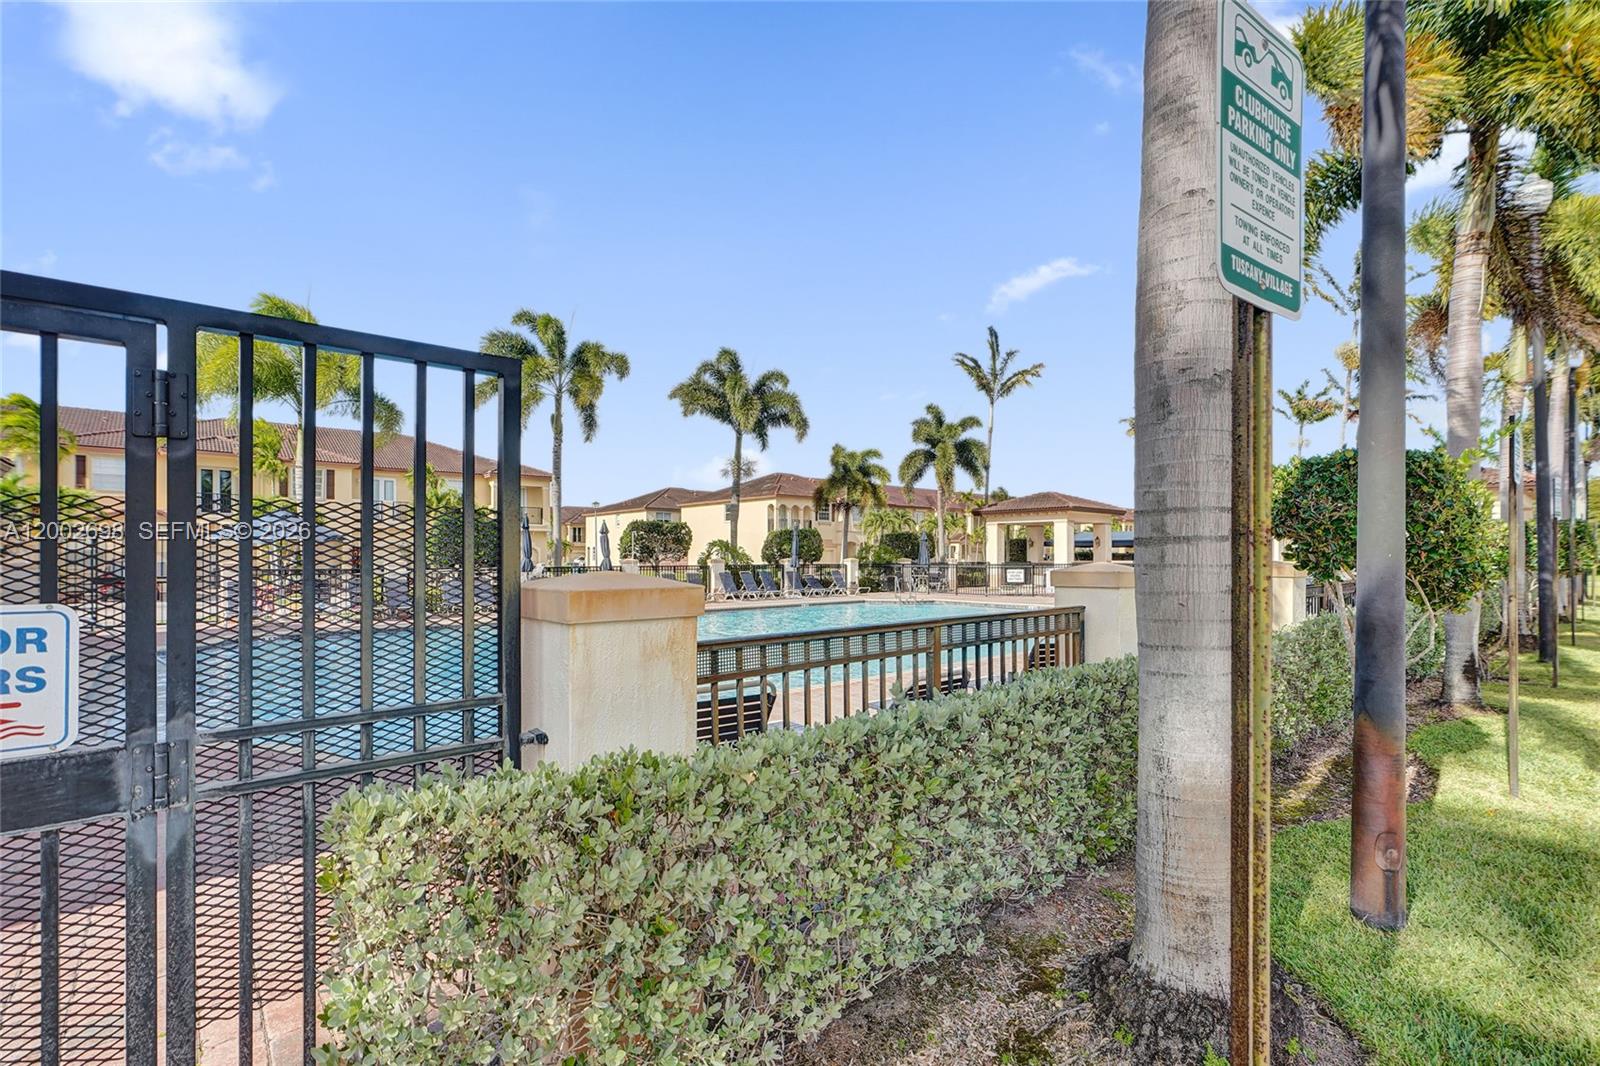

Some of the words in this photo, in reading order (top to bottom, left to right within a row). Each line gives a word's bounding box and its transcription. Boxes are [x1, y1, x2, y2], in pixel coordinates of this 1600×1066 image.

[1235, 84, 1291, 144] CLUBHOUSE
[1228, 104, 1271, 154] PARKING
[1274, 139, 1296, 170] ONLY
[1228, 154, 1241, 172] WILL
[1242, 164, 1250, 178] BE
[1251, 169, 1269, 189] TOWED
[1270, 182, 1276, 194] AT
[1277, 187, 1296, 207] VEHICLE
[1229, 140, 1270, 176] UNAUTHORIZED
[1272, 169, 1295, 193] VEHICLES
[1251, 199, 1275, 222] EXPENCE
[1256, 187, 1264, 201] OR
[1234, 214, 1259, 239] TOWING
[1260, 230, 1290, 255] ENFORCED
[1242, 235, 1250, 247] AT
[1252, 240, 1264, 255] ALL
[1266, 247, 1283, 264] TIMES
[1231, 254, 1263, 285] TUSCANY
[1264, 271, 1293, 298] VILLAGE
